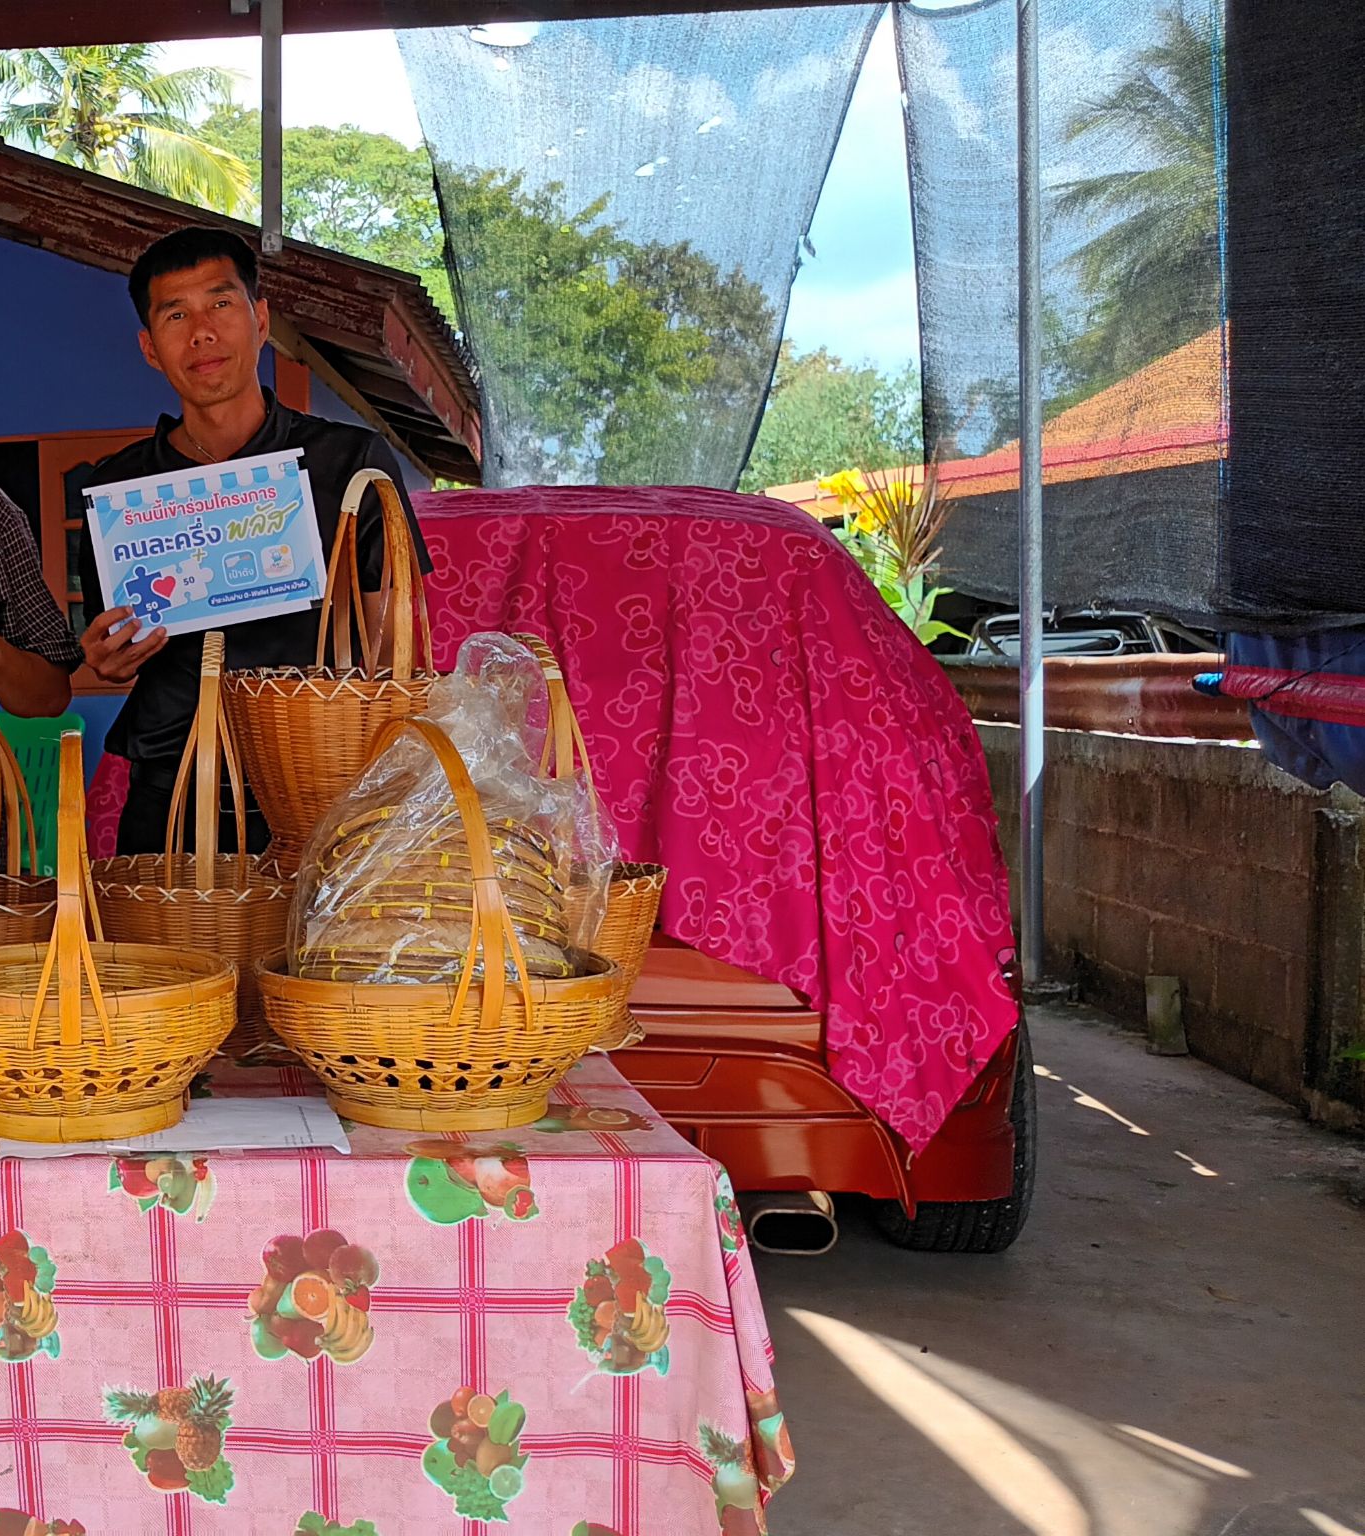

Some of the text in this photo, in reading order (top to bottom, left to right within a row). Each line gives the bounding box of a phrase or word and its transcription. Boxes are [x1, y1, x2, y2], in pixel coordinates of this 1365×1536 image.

[124, 486, 277, 526] ร้านนี้เข้าร่วมโครงการ
[113, 502, 298, 562] คนละครึ่ง พลัส
[183, 576, 195, 586] 50
[145, 601, 159, 611] 50
